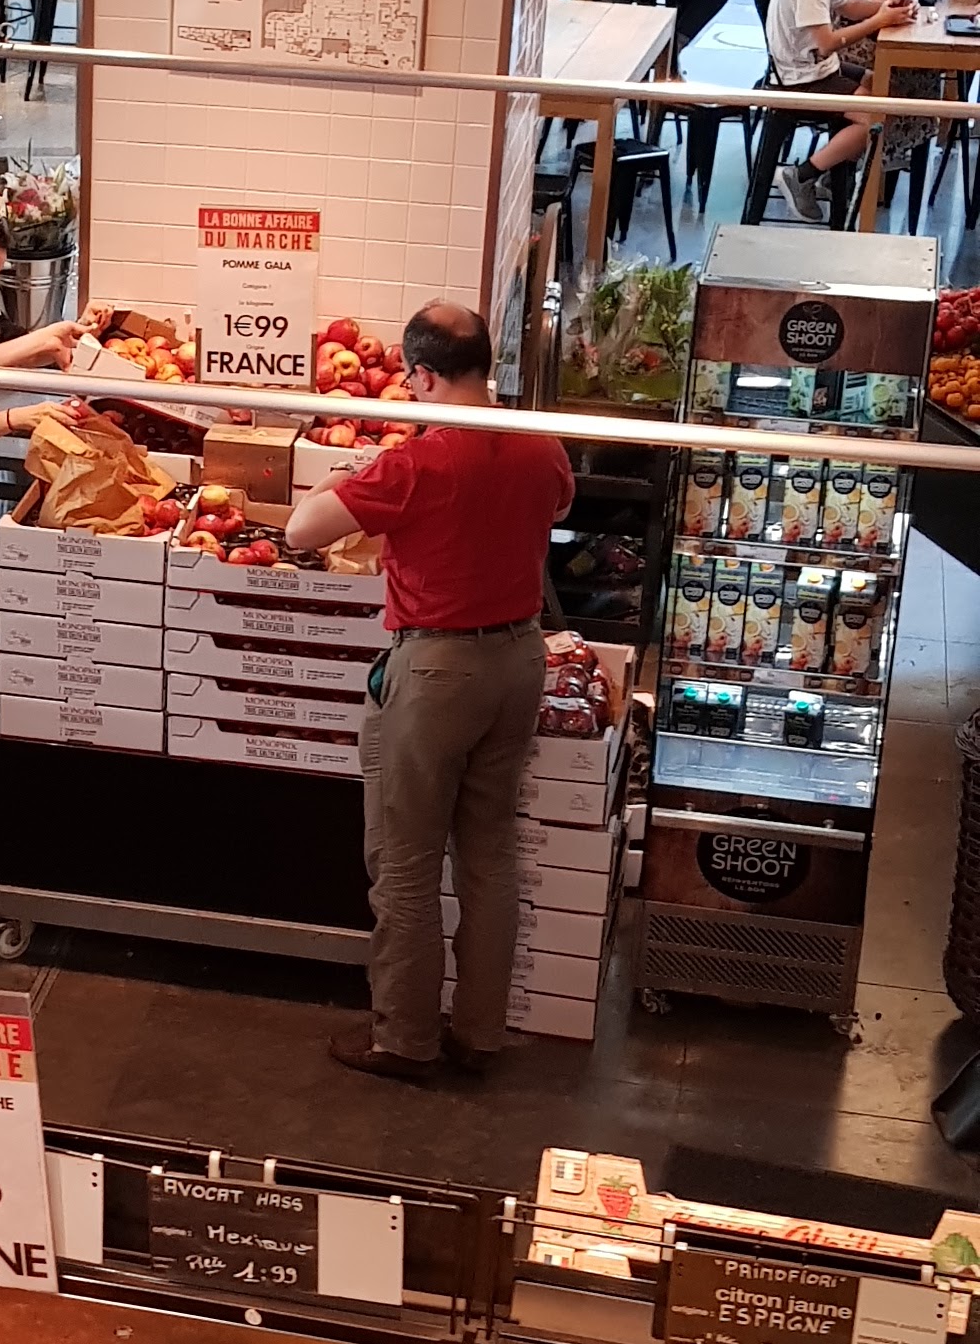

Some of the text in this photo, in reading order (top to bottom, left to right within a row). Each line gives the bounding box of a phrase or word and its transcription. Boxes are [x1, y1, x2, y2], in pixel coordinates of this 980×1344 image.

[204, 212, 314, 229] LA BONNE AFFAIRE
[205, 232, 226, 248] DU
[223, 260, 292, 270] POMME GALA
[224, 313, 289, 338] 1€99
[786, 331, 836, 346] SHOOT
[207, 351, 305, 376] FRANCE
[57, 535, 102, 546] MONOPRIX
[246, 568, 300, 579] MONOPRIX
[57, 579, 101, 589] MONOPRIX
[242, 611, 295, 623] MONOPRIX
[57, 622, 101, 633] MONOPRIX
[242, 654, 293, 666] MONOPRIX
[58, 664, 102, 674] MONOPRIX
[245, 696, 296, 708] MONOPRIX
[59, 706, 102, 716] MONOPRIX
[246, 737, 298, 750] MONOPRIX
[711, 852, 795, 878] SHOOT
[163, 1177, 304, 1212] AVOCAT HASS
[715, 1286, 853, 1320] citron jaune
[718, 1304, 836, 1335] ESPAGNE
